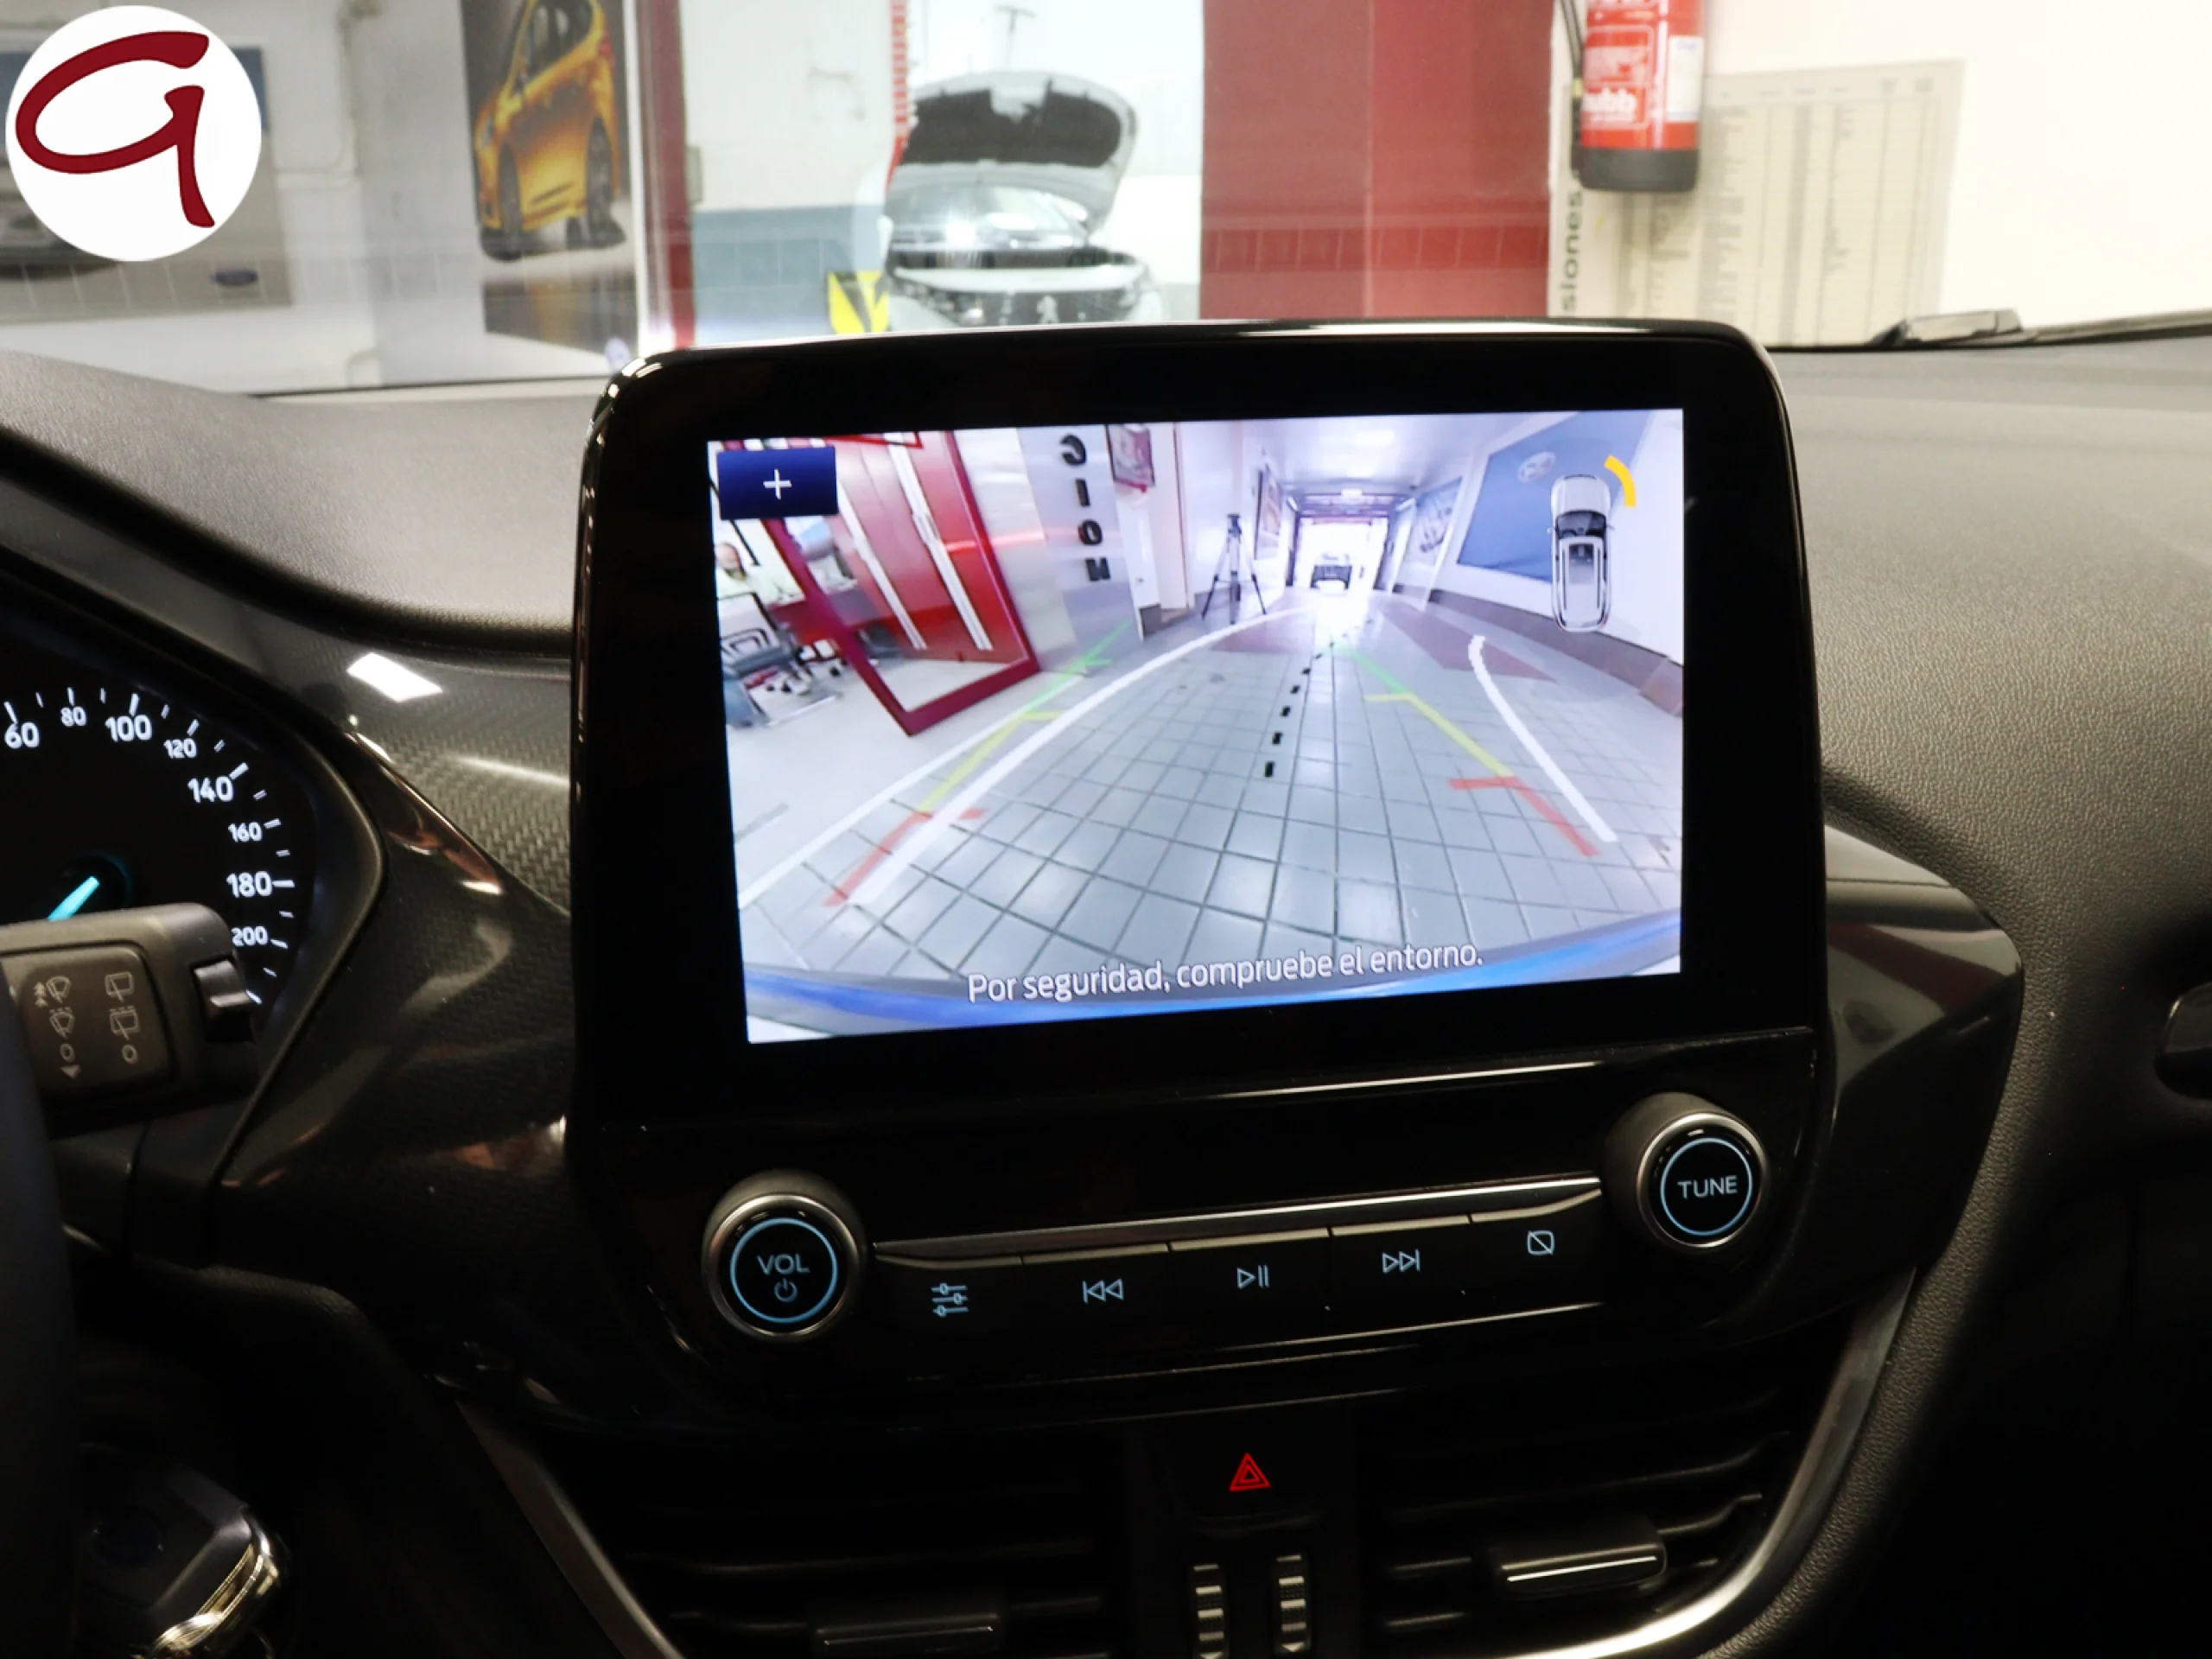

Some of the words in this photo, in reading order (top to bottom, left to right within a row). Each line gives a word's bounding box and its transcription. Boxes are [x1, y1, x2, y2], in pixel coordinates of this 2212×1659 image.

[60, 706, 86, 727] 80
[105, 714, 152, 742] 100
[4, 721, 39, 749] 60
[163, 737, 197, 759] 120
[188, 776, 233, 803] 140
[227, 822, 263, 842] 160
[226, 870, 272, 898] 180
[231, 925, 269, 947] 200
[968, 974, 1017, 1002] Por
[1023, 959, 1171, 1003] seguridad,
[1176, 949, 1333, 988] compruebe
[1338, 944, 1364, 976] el
[1370, 943, 1484, 972] entorno.
[1676, 1174, 1738, 1200] TUNE
[756, 1253, 810, 1275] VOL
